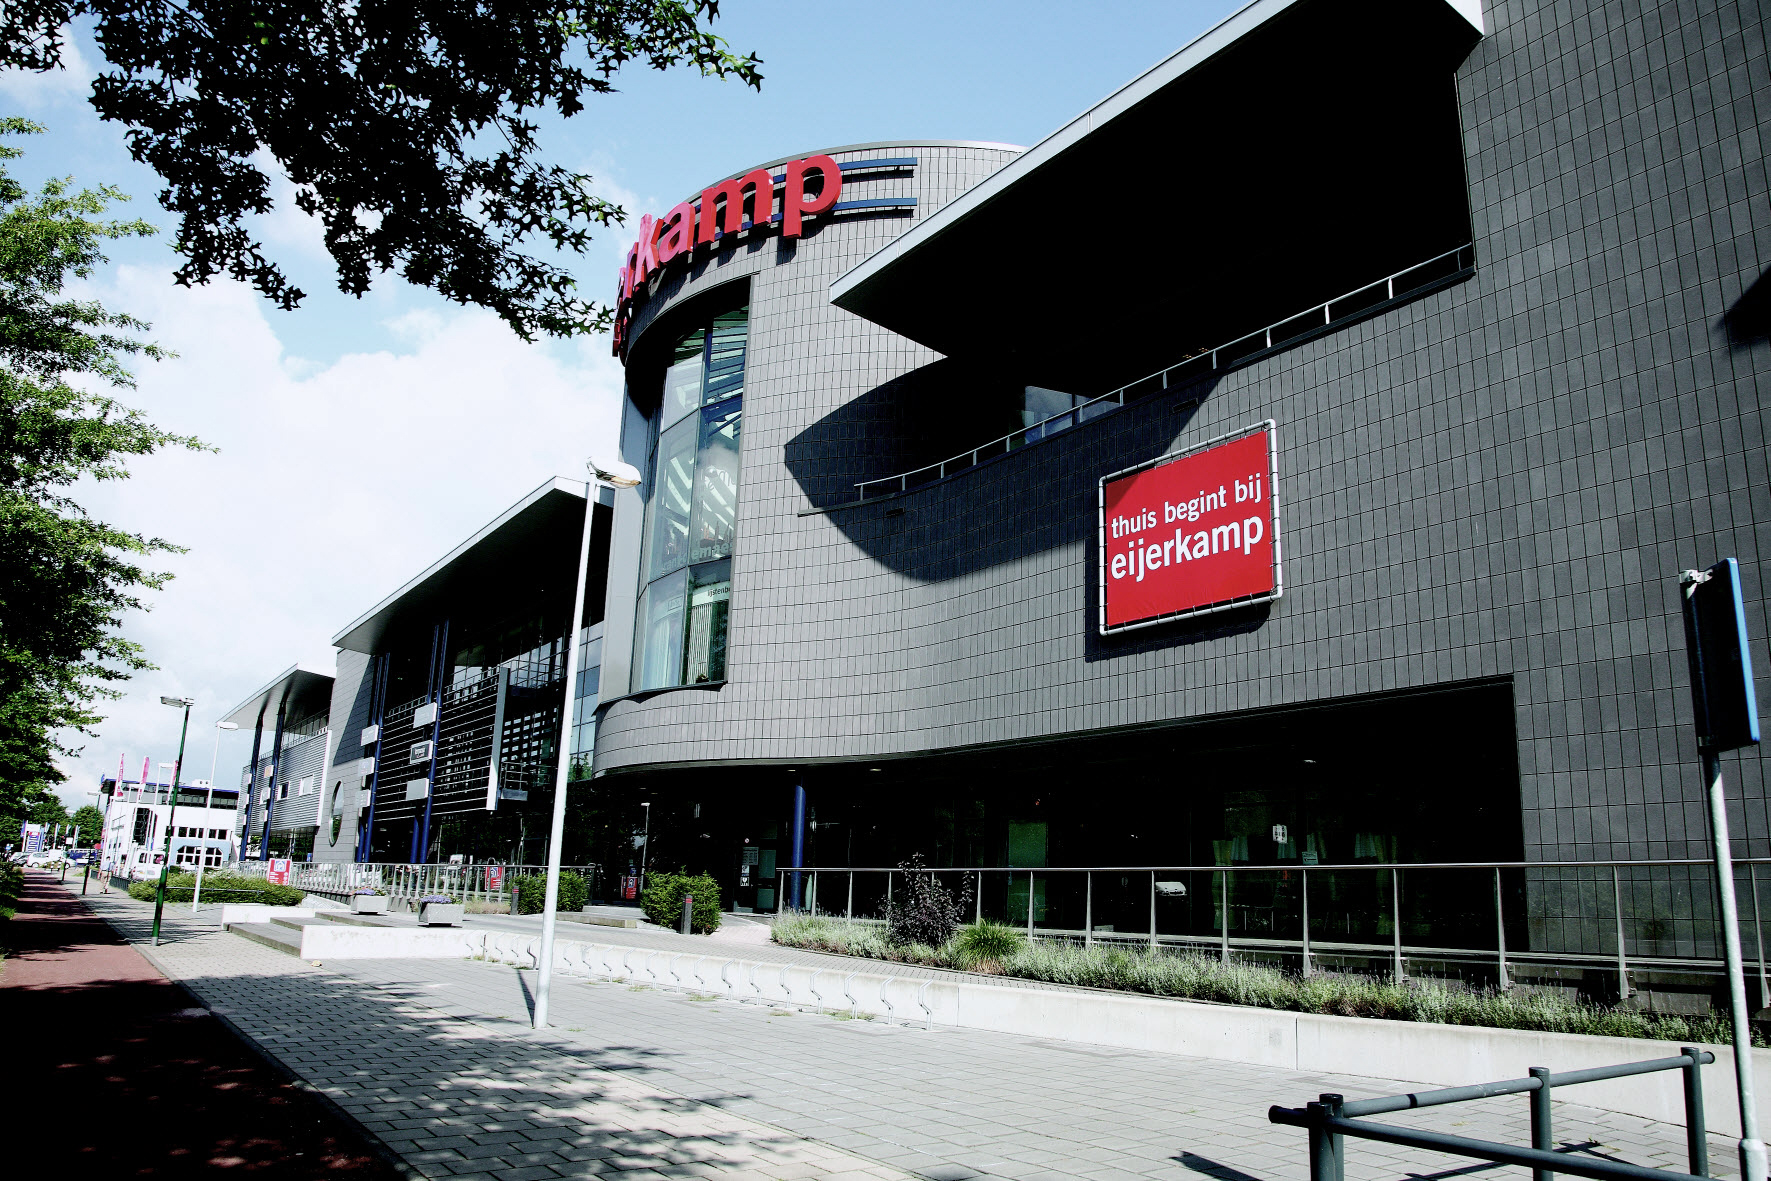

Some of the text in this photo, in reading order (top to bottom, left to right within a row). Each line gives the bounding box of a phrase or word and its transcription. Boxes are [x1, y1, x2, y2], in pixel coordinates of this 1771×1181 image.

[1111, 473, 1262, 539] thuis begint bij
[1111, 515, 1264, 582] eijerkamp
